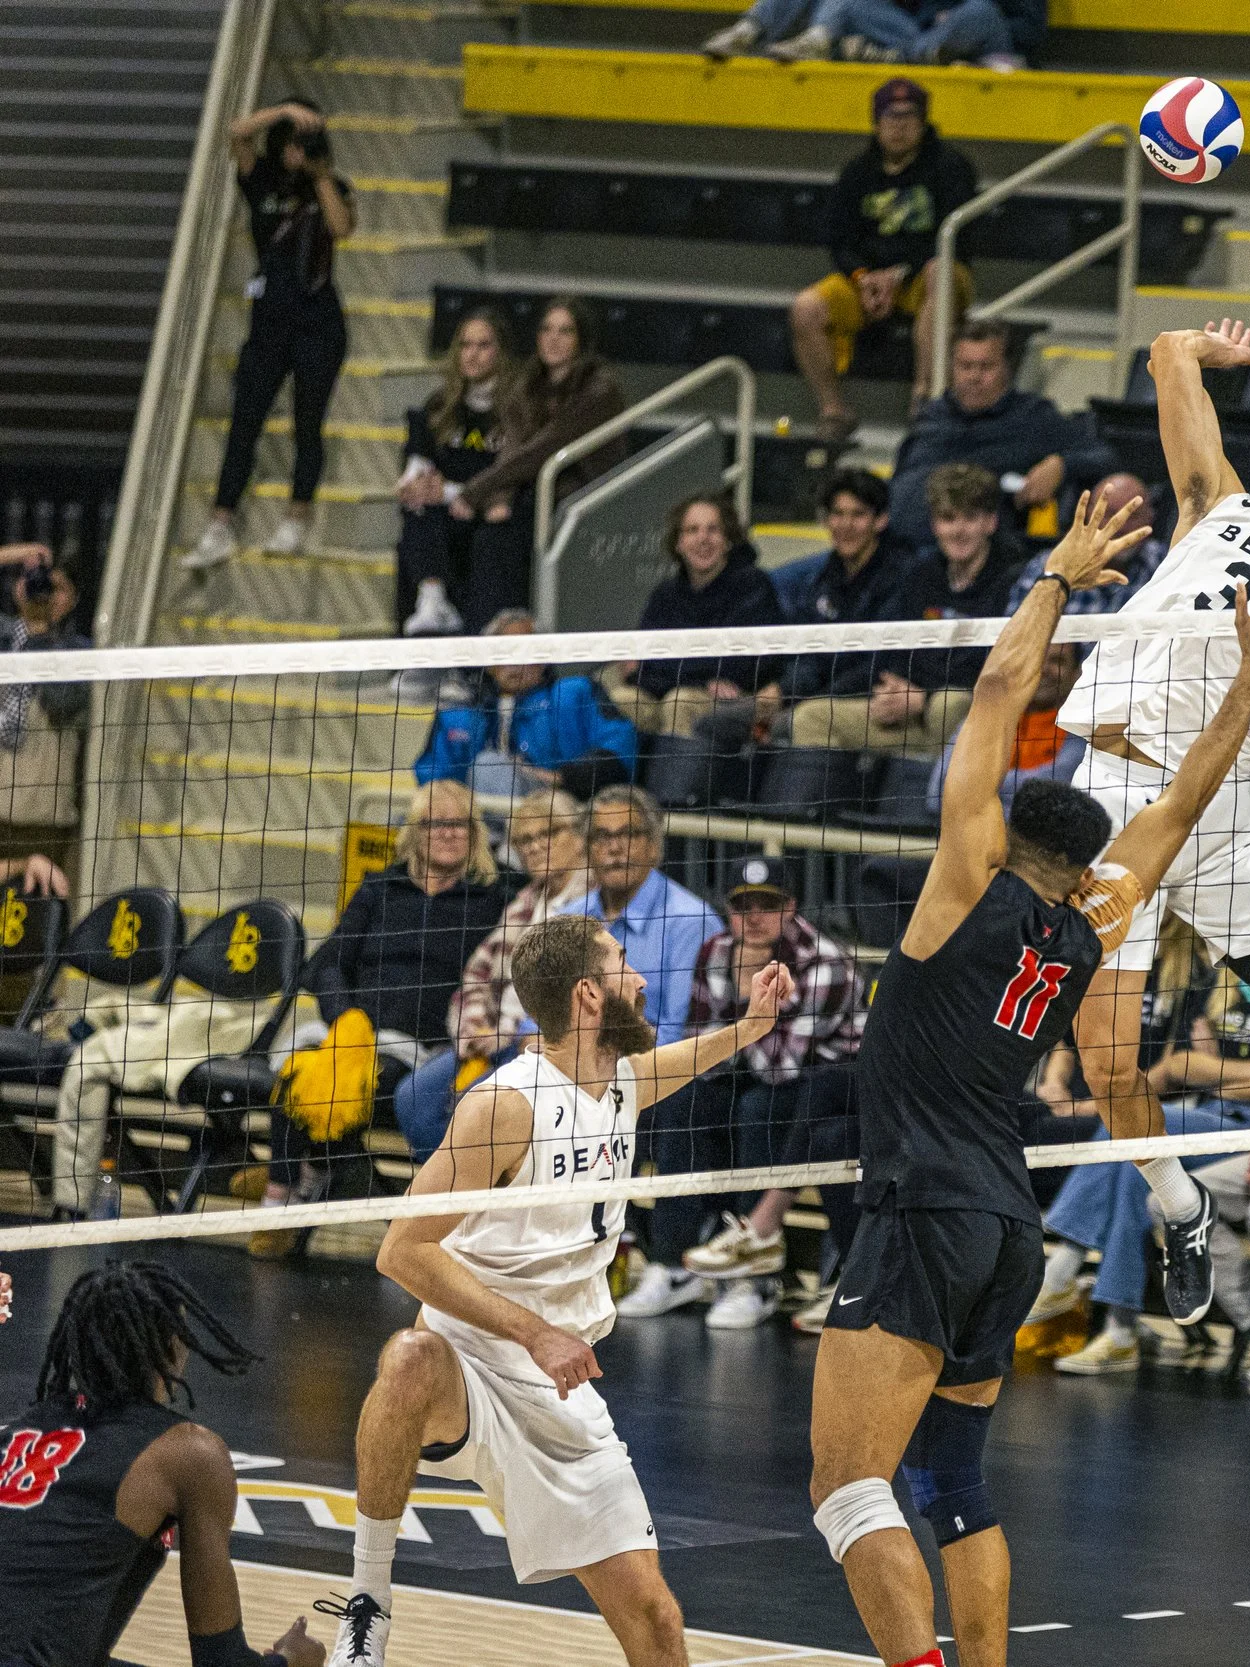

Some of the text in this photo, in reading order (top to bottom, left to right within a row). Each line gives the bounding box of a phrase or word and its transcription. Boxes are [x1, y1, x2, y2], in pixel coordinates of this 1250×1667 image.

[1146, 142, 1177, 173] NCAA
[1155, 130, 1184, 158] molten
[993, 945, 1072, 1040] 11
[0, 1428, 86, 1510] 18
